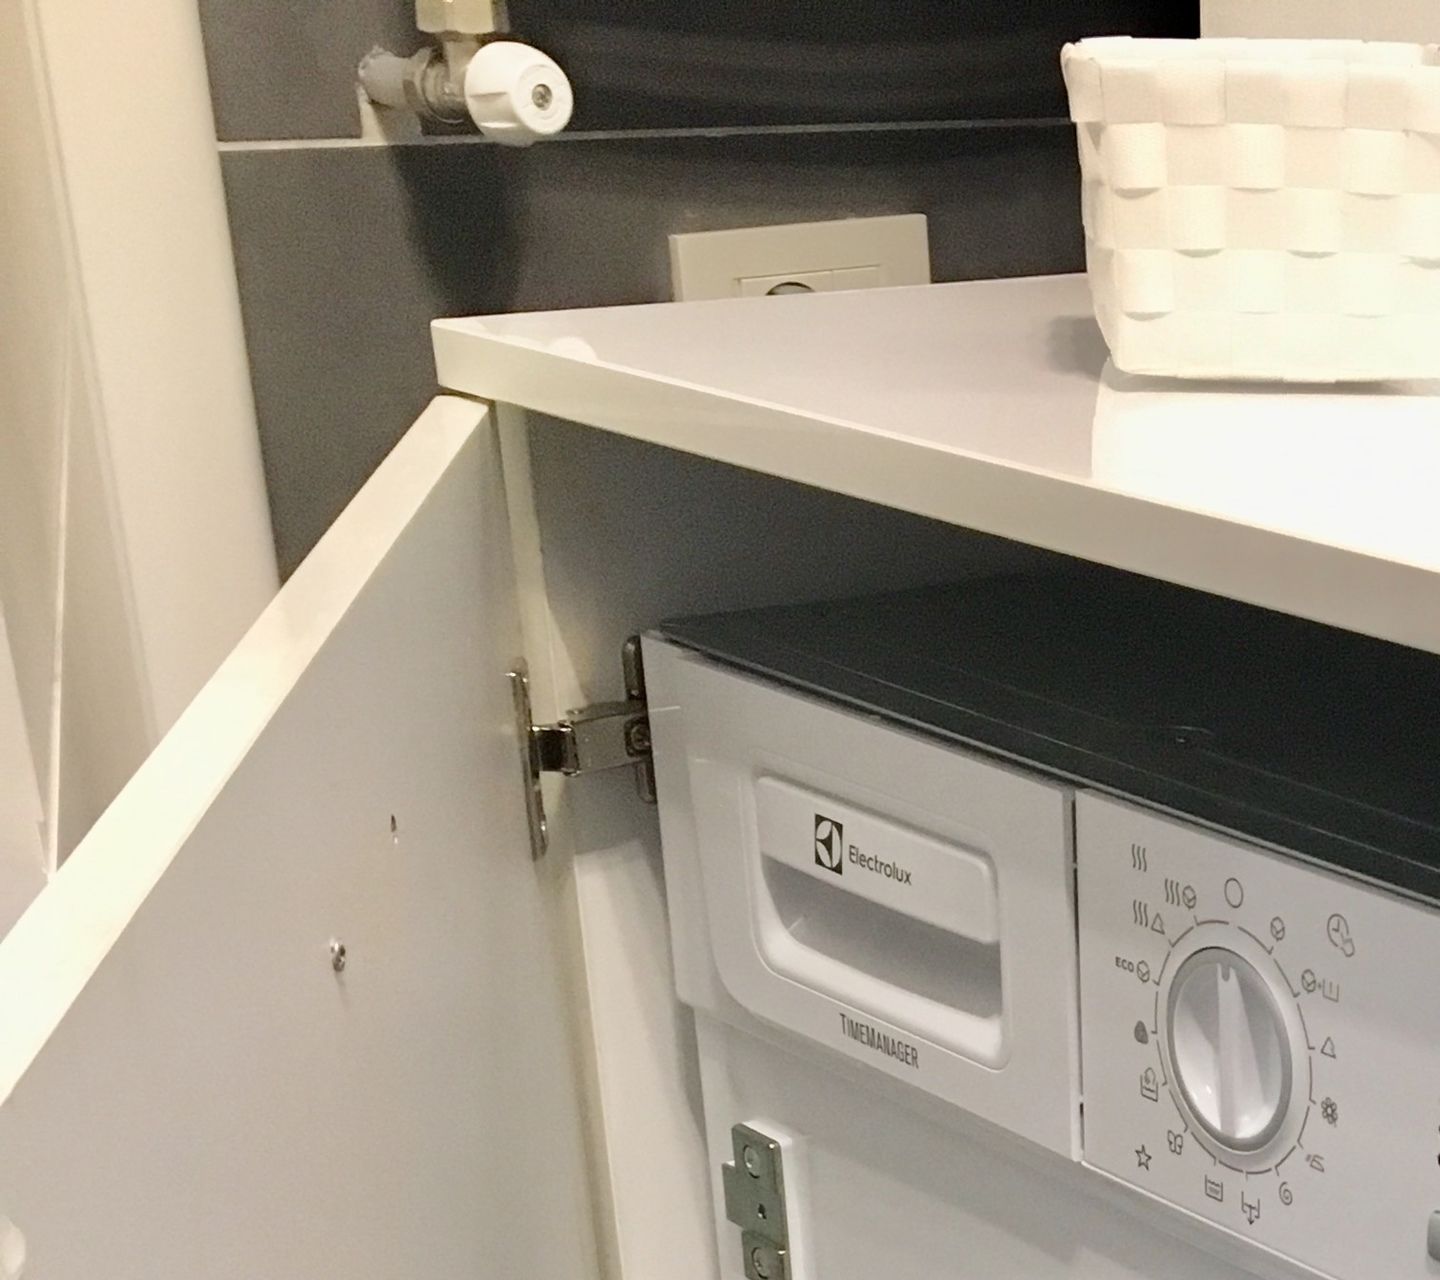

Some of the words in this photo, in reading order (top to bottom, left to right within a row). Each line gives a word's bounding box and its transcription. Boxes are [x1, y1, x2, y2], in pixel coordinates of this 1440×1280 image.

[848, 844, 913, 887] Electrolux
[1115, 956, 1134, 974] ECO
[839, 1012, 919, 1070] TIMEMANAGER
